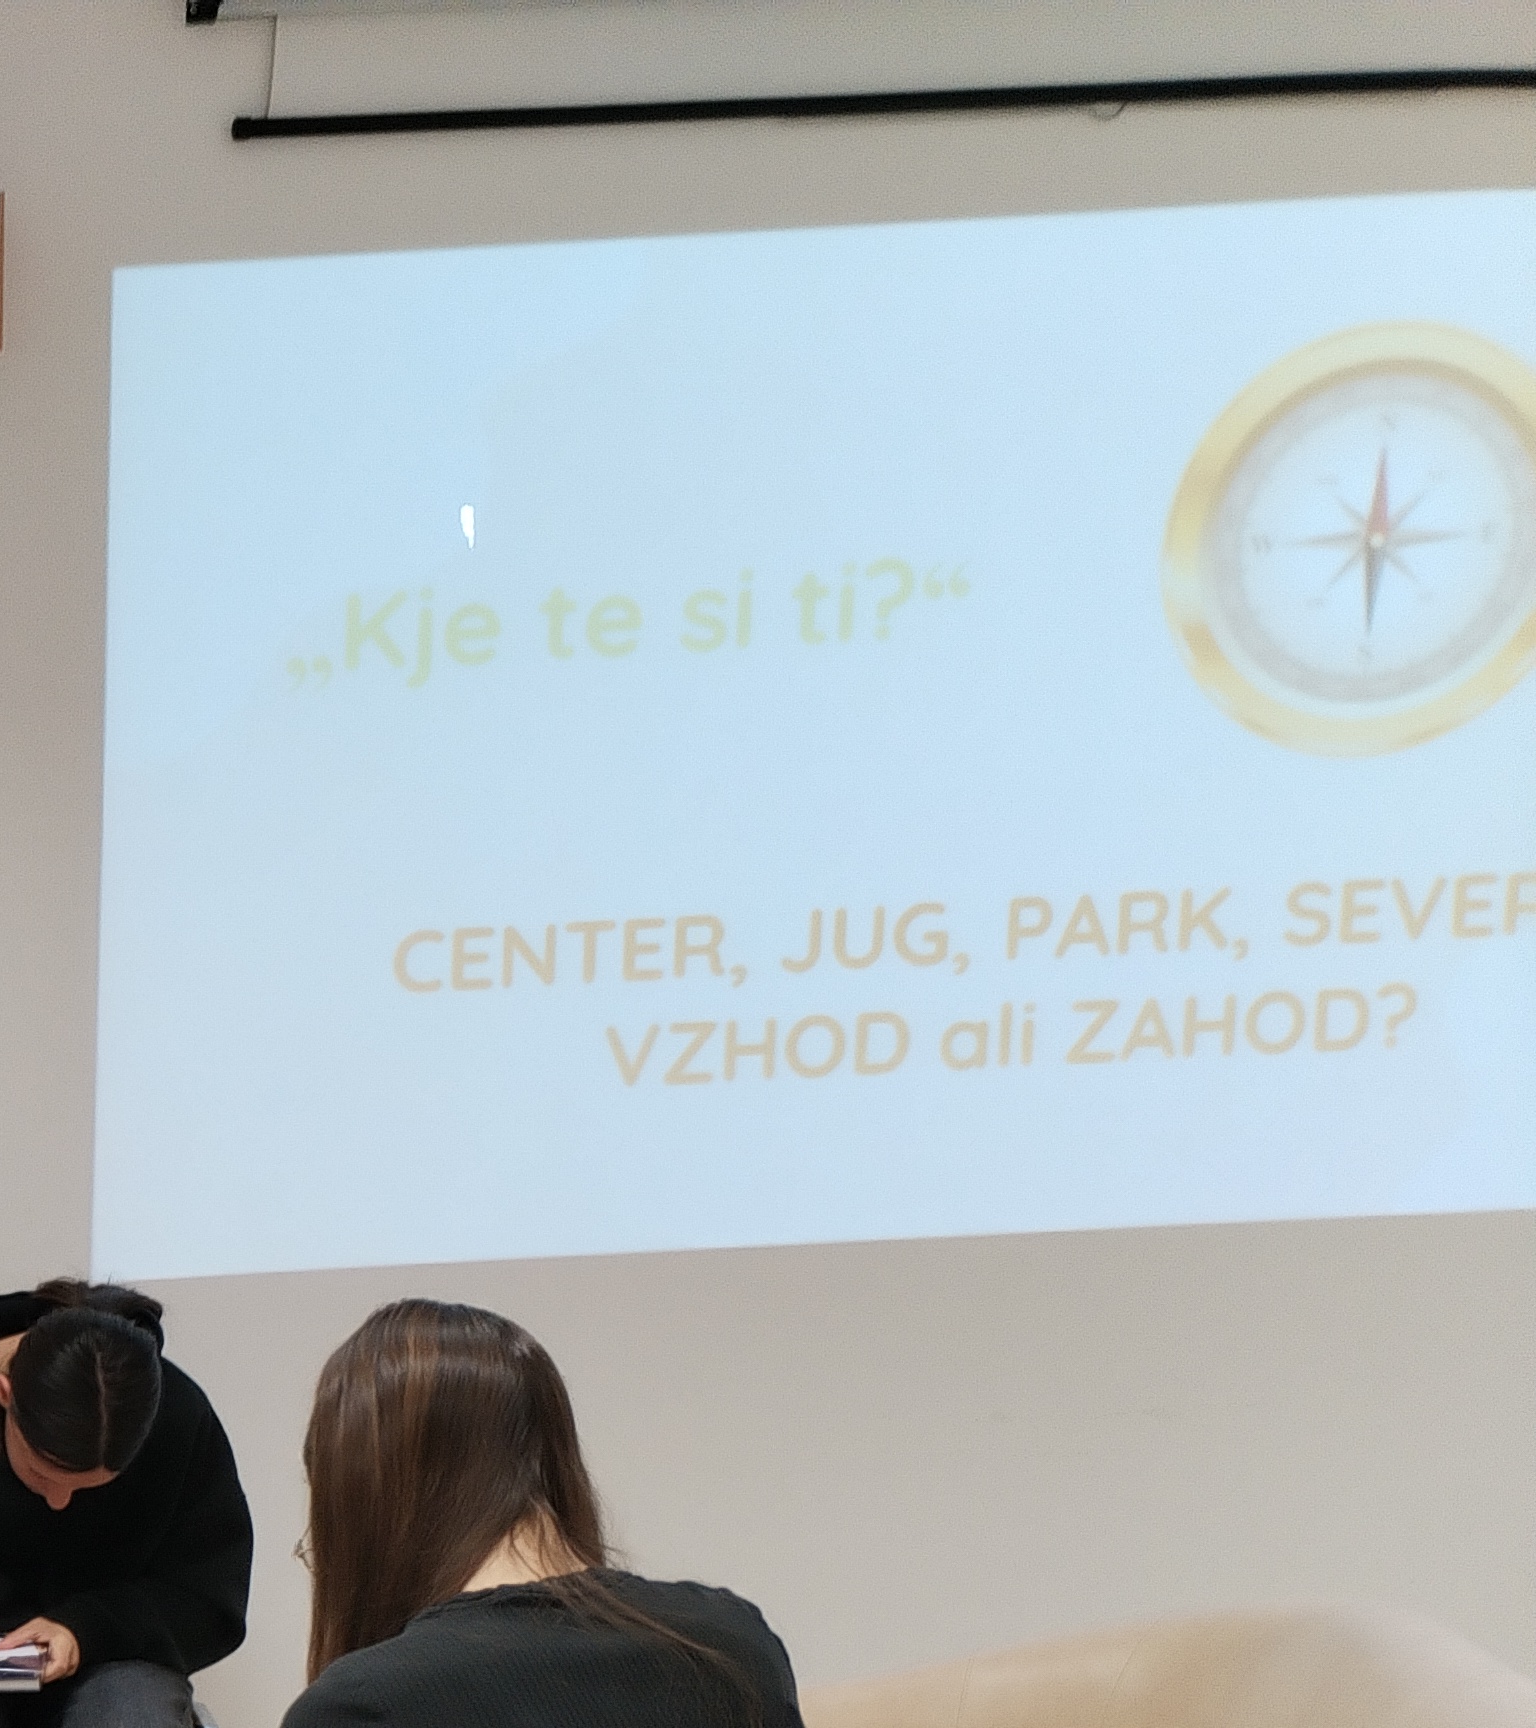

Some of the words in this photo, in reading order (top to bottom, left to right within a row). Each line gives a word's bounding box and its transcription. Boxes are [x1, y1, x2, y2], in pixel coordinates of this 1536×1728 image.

[539, 587, 643, 659] te
[679, 566, 756, 655] si
[392, 914, 748, 993] CENTER,
[780, 902, 971, 976] JUG,
[1006, 887, 1250, 962] PARK,
[606, 1011, 912, 1087] VZHOD
[939, 1001, 1036, 1071] ali
[1065, 982, 1419, 1066] ZAHOD?
